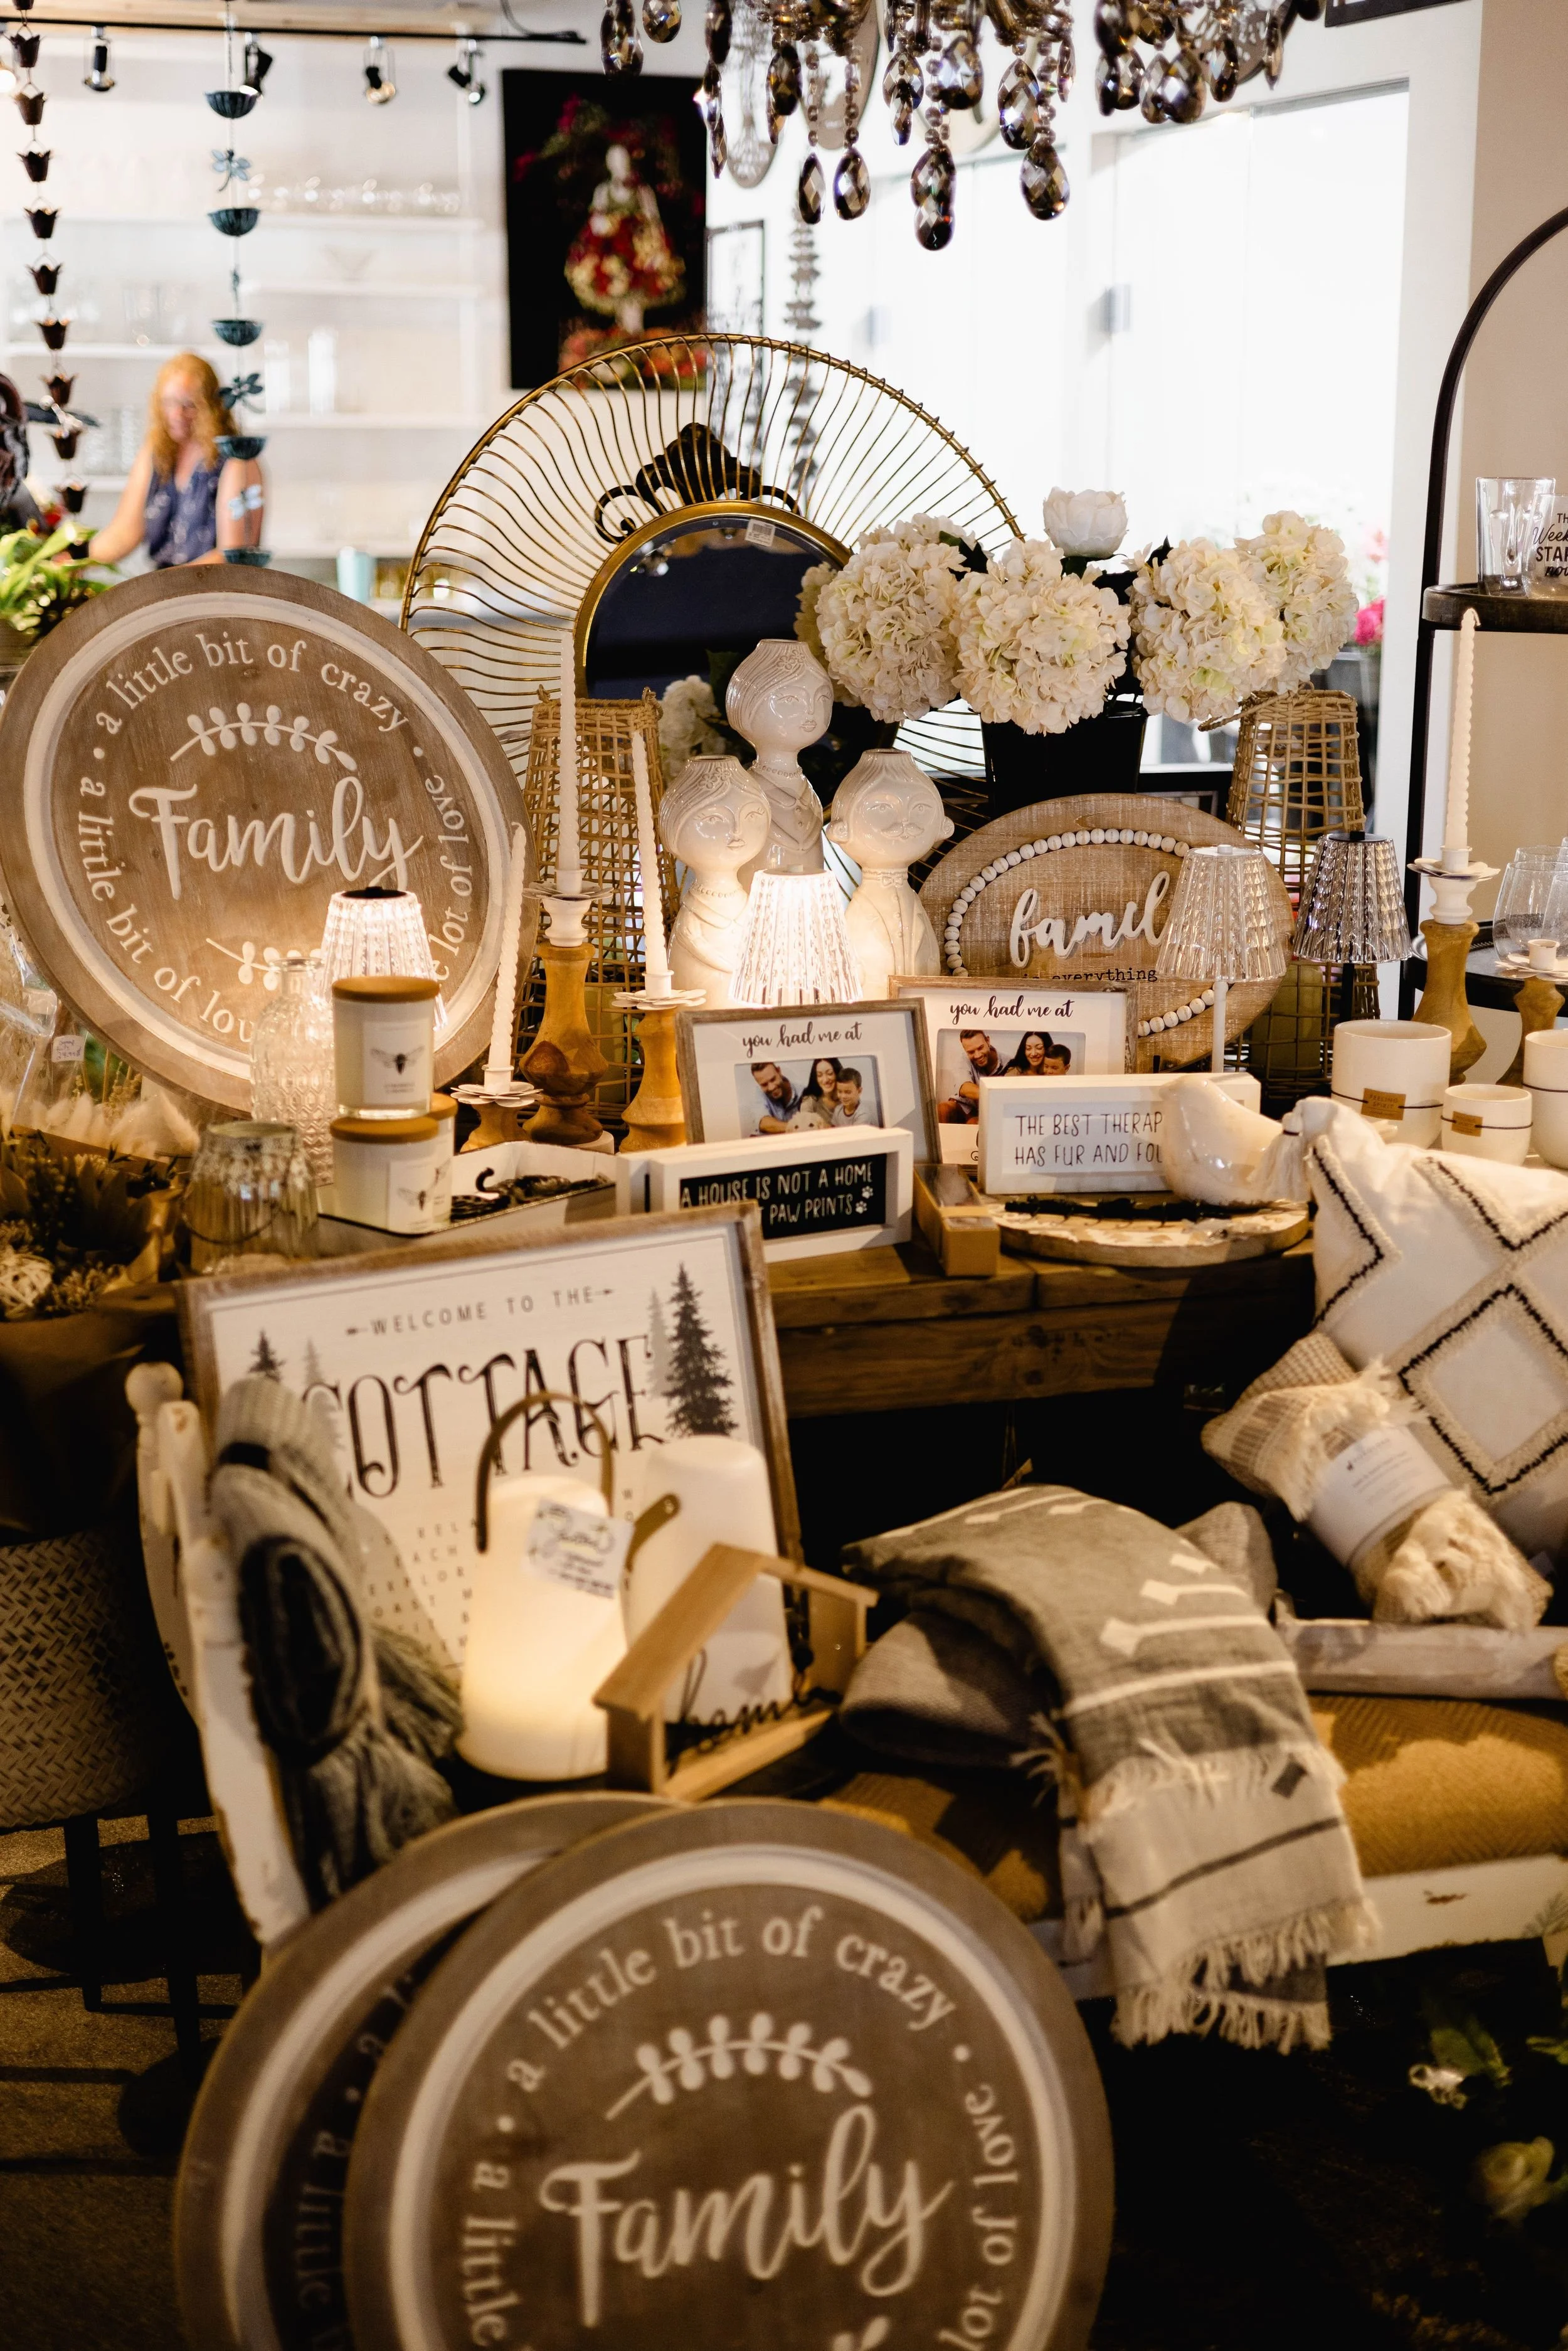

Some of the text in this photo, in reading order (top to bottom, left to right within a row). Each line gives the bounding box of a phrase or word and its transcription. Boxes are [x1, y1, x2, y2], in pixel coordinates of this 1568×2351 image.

[96, 630, 410, 735] a little bit of crazy
[80, 777, 106, 797] a
[425, 774, 469, 846] love
[78, 811, 116, 902] little
[129, 775, 423, 900] Family
[441, 853, 473, 898] of
[106, 904, 154, 964] bit
[428, 906, 469, 957] lot
[154, 967, 201, 1004] of
[950, 995, 1075, 1025] you had me at
[743, 1021, 862, 1057] you had me at
[1015, 1111, 1163, 1137] THE BEST THERAP
[1015, 1146, 1046, 1167] HAS
[1055, 1144, 1084, 1167] FUR
[1093, 1144, 1128, 1163] AND
[681, 1162, 872, 1208] A HOUSE IS NOT A HOME
[770, 1194, 854, 1226] PAW PRINTS
[371, 1286, 595, 1335] WELCOME TO THE
[507, 1906, 956, 2093] a little bit of crazy
[965, 2084, 1019, 2188] love
[538, 2105, 955, 2328] Family
[463, 2162, 522, 2347] a little
